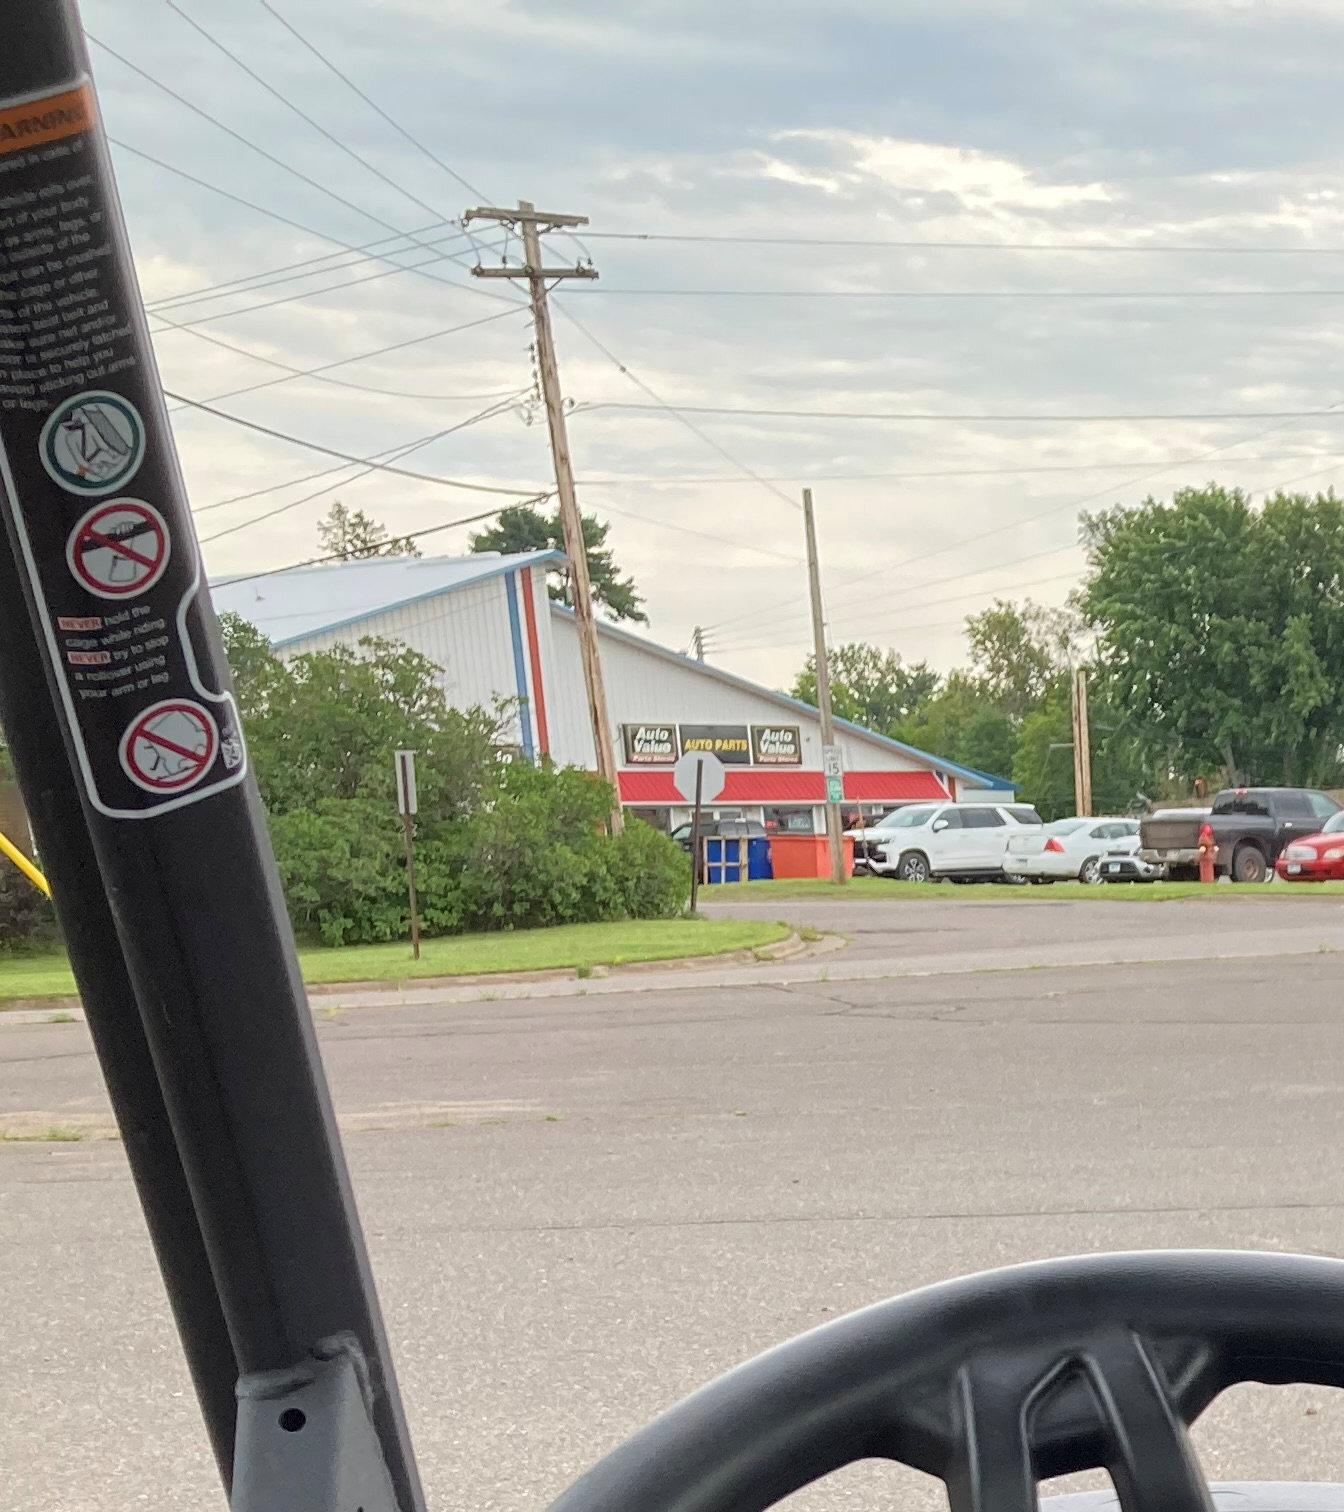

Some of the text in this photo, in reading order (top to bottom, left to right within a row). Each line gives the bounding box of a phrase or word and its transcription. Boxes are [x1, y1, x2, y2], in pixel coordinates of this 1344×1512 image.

[635, 727, 669, 741] Auto
[762, 729, 792, 742] Auto
[634, 740, 672, 753] Value
[684, 739, 748, 751] AUTO PARTS
[760, 739, 795, 754] Value
[829, 763, 840, 775] 15
